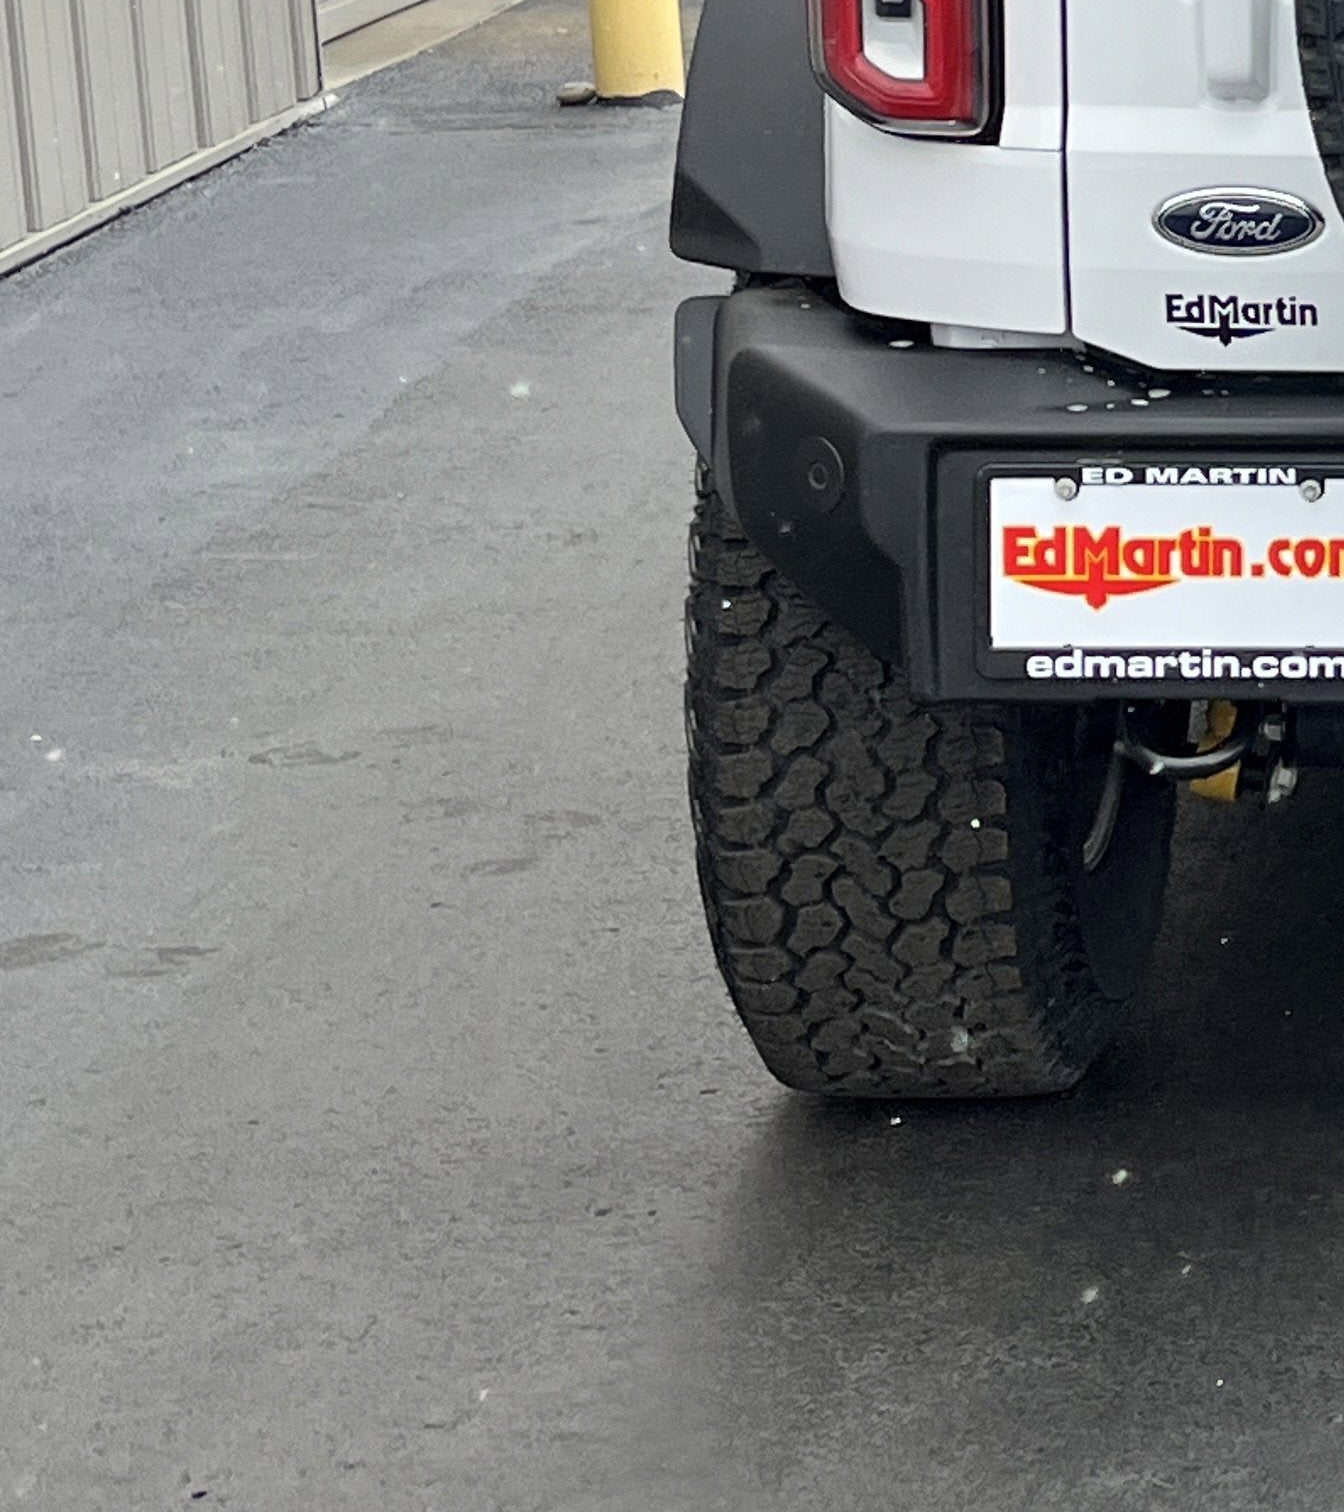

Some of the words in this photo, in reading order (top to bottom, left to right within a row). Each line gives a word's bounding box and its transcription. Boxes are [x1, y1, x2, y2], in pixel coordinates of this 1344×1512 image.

[1190, 201, 1283, 240] Ford
[1080, 467, 1134, 485] ED
[1144, 467, 1297, 485] MARTIN
